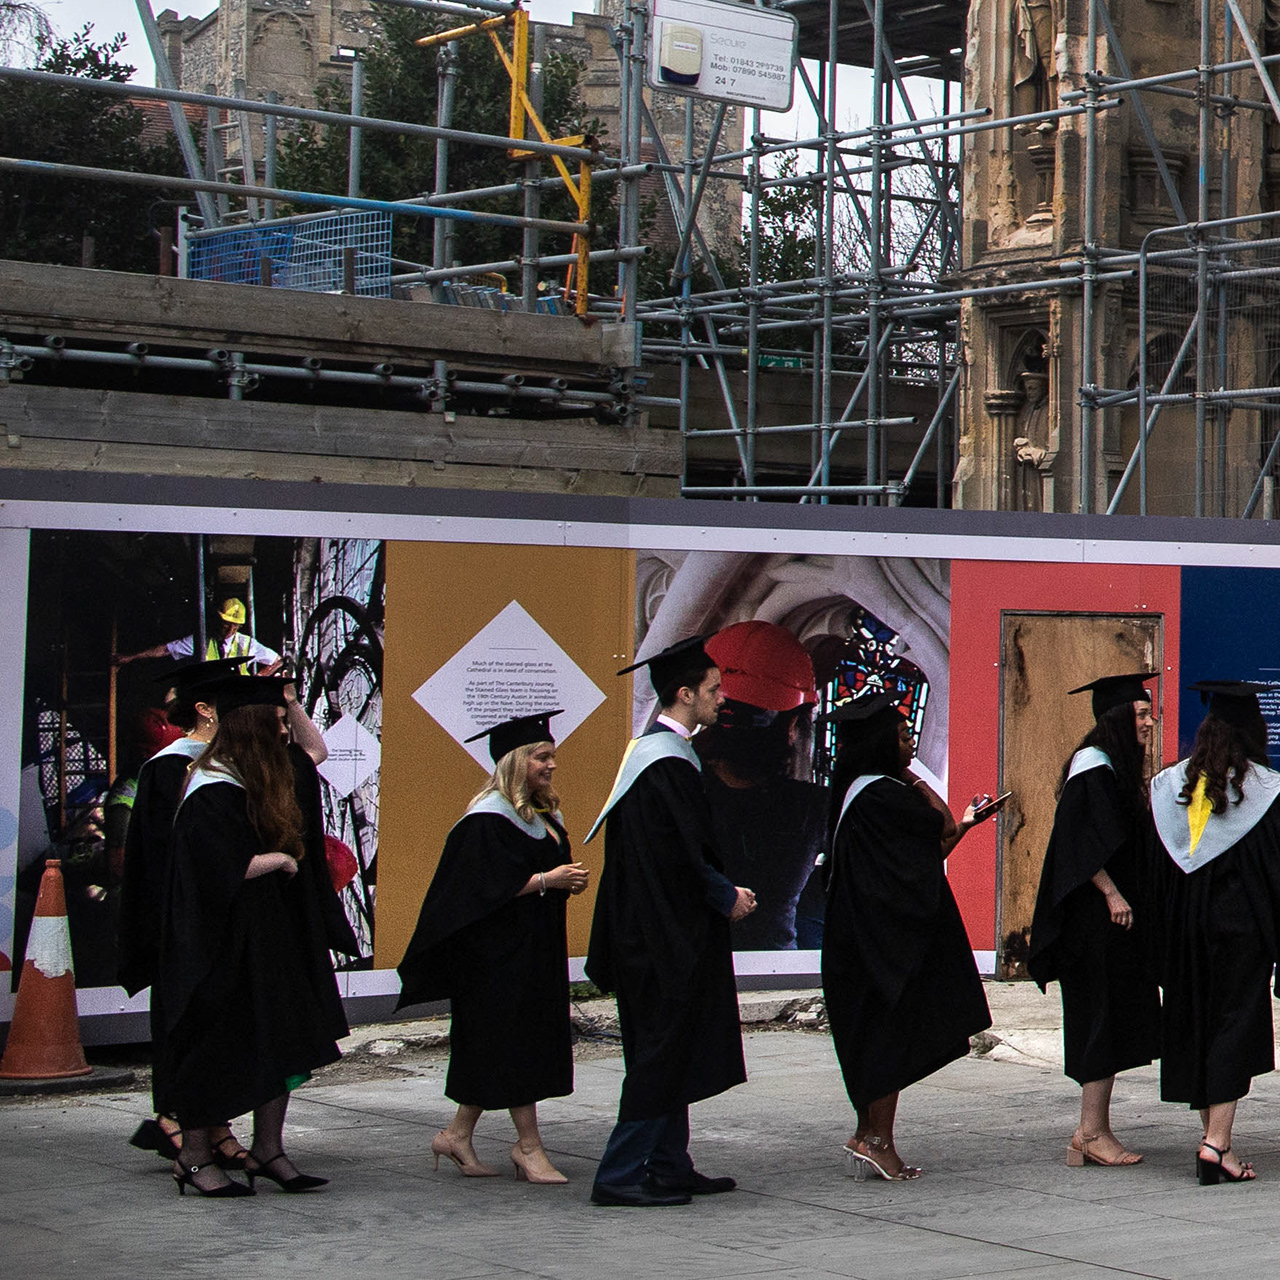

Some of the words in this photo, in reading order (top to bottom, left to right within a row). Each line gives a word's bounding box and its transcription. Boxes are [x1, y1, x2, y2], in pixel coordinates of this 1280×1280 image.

[710, 33, 746, 49] Secure
[714, 54, 728, 63] Tel:
[711, 62, 730, 72] Mob:
